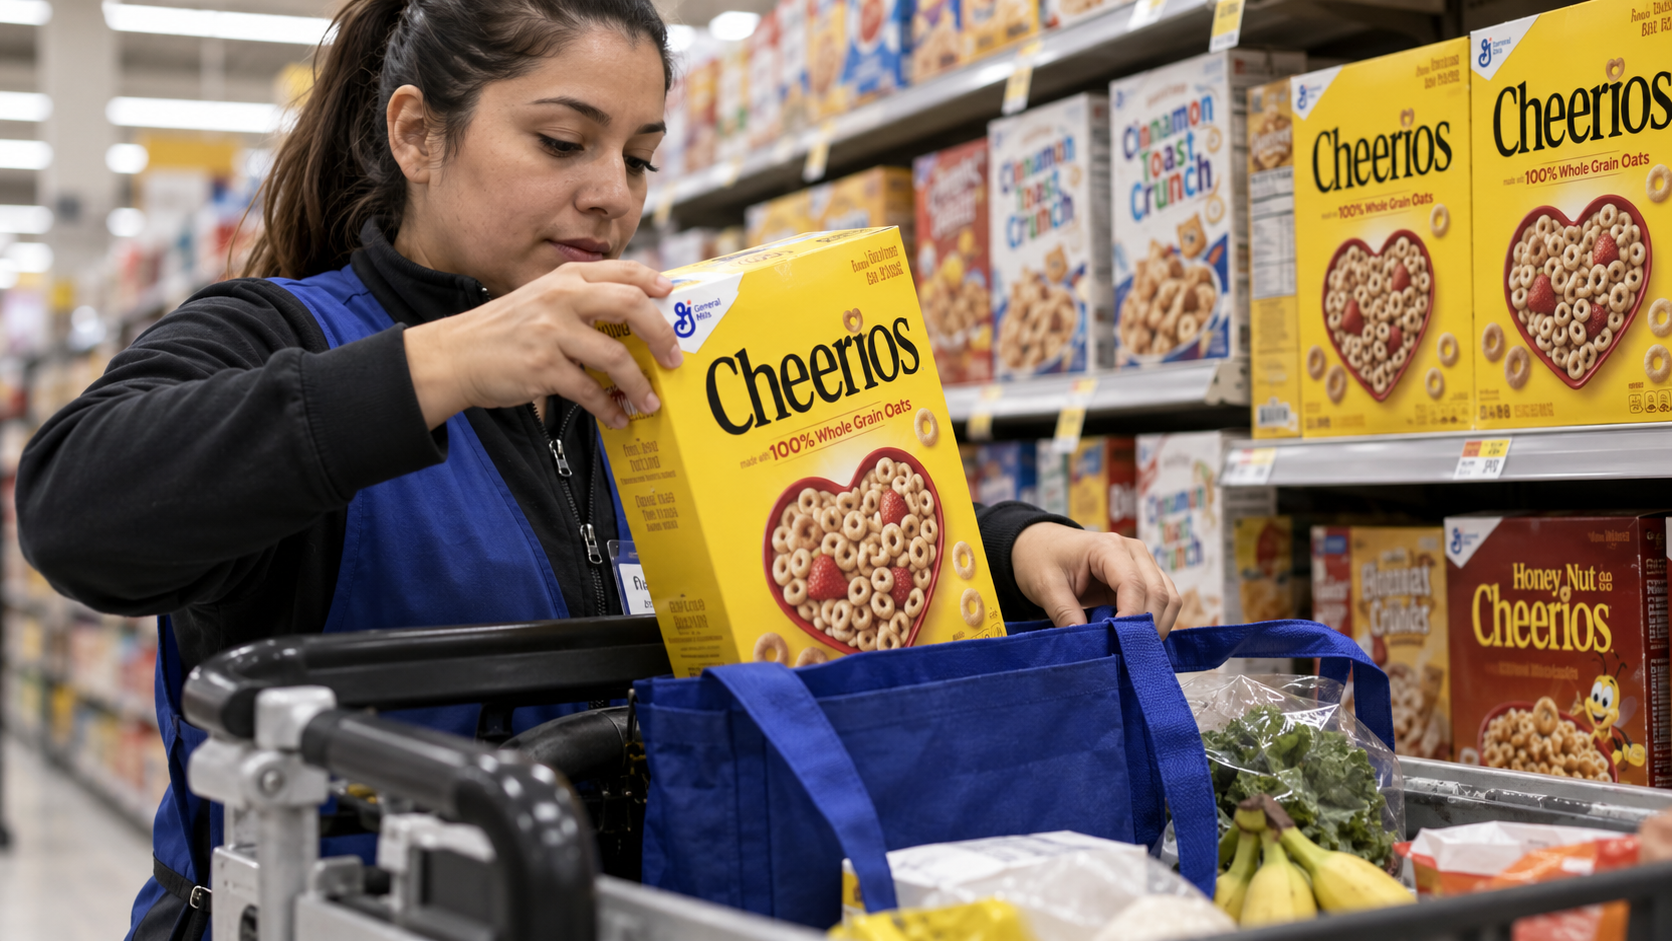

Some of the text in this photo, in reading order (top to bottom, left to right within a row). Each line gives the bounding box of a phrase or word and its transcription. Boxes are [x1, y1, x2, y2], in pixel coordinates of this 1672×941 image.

[1123, 95, 1214, 160] Cinnamon
[1493, 71, 1672, 158] Cheerios
[1130, 153, 1212, 222] Crunch
[1141, 131, 1195, 182] Toast
[1312, 121, 1453, 193] Cheerios
[1525, 166, 1557, 185] 100%
[1559, 162, 1589, 178] Whole
[1591, 156, 1619, 173] Grain
[1621, 152, 1649, 168] Oats
[1338, 203, 1364, 219] 100%
[1365, 200, 1388, 214] Whole
[1389, 195, 1411, 210] Grain
[1412, 192, 1434, 206] Oats
[694, 298, 721, 312] General
[706, 317, 920, 435] Cheerios
[769, 432, 815, 460] 100%
[815, 421, 852, 443] Whole
[853, 409, 884, 429] Grain
[885, 399, 912, 418] Oats
[1513, 562, 1597, 597] Honey Nut
[1472, 582, 1612, 654] Cheerios
